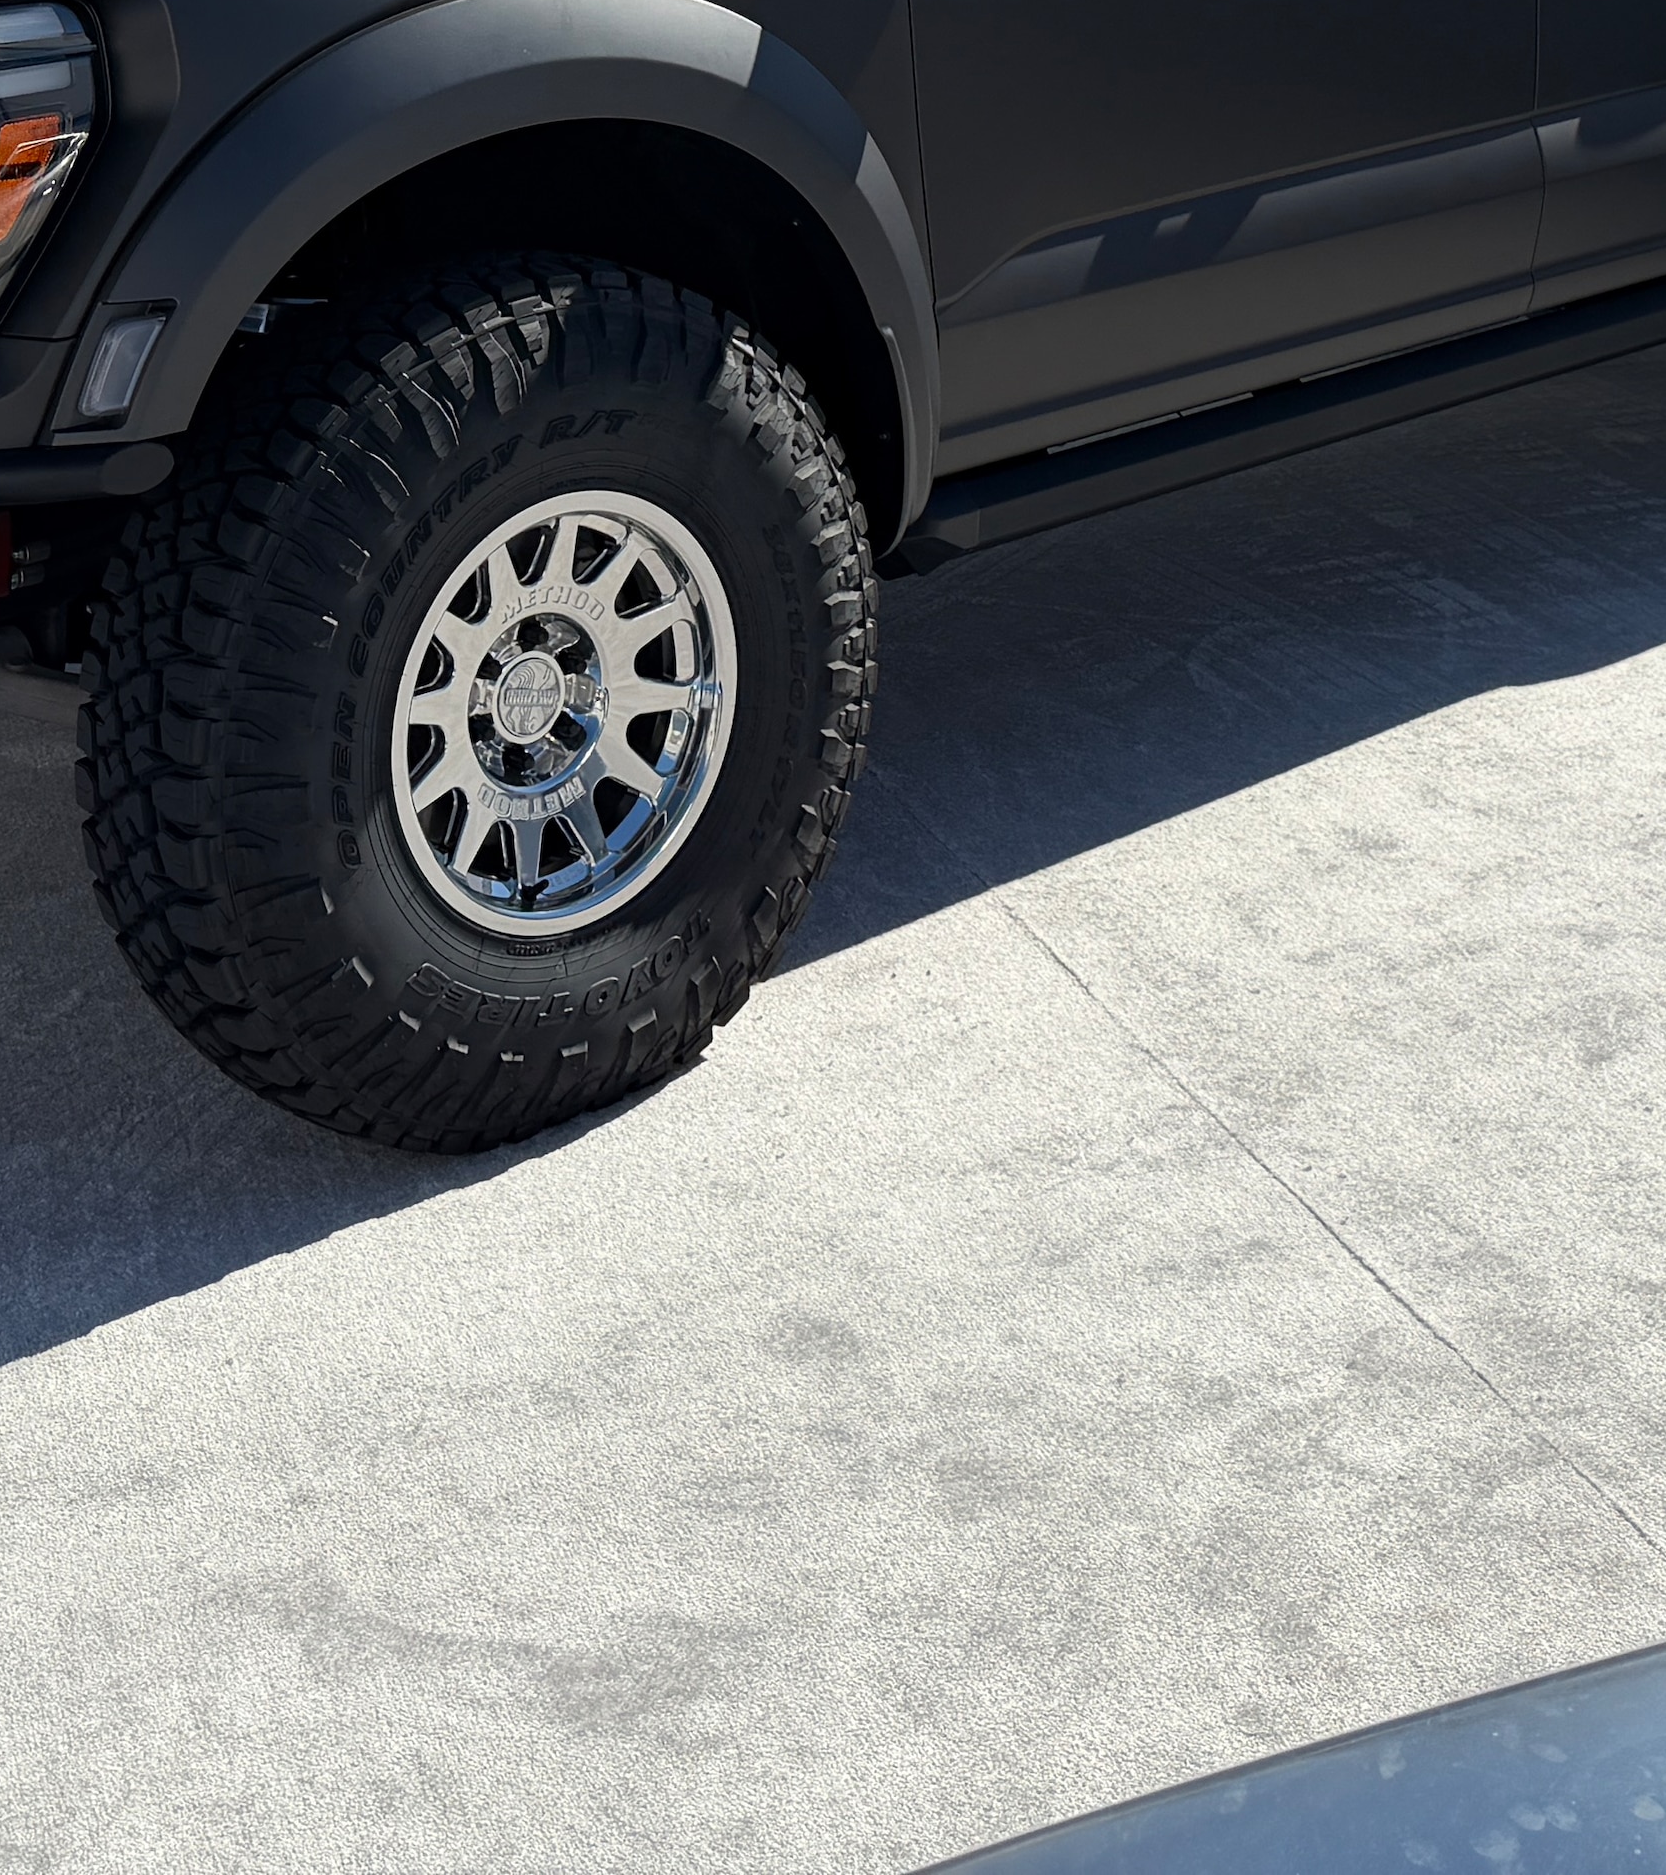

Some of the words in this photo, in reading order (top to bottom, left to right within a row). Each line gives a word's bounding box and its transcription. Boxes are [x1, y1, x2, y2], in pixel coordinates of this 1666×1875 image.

[500, 584, 606, 626] METHOD
[331, 691, 362, 872] OPEN
[348, 432, 523, 679] COUNTRY
[539, 409, 639, 450] R/T
[477, 775, 587, 821] METHOD
[405, 962, 574, 1028] TIRES
